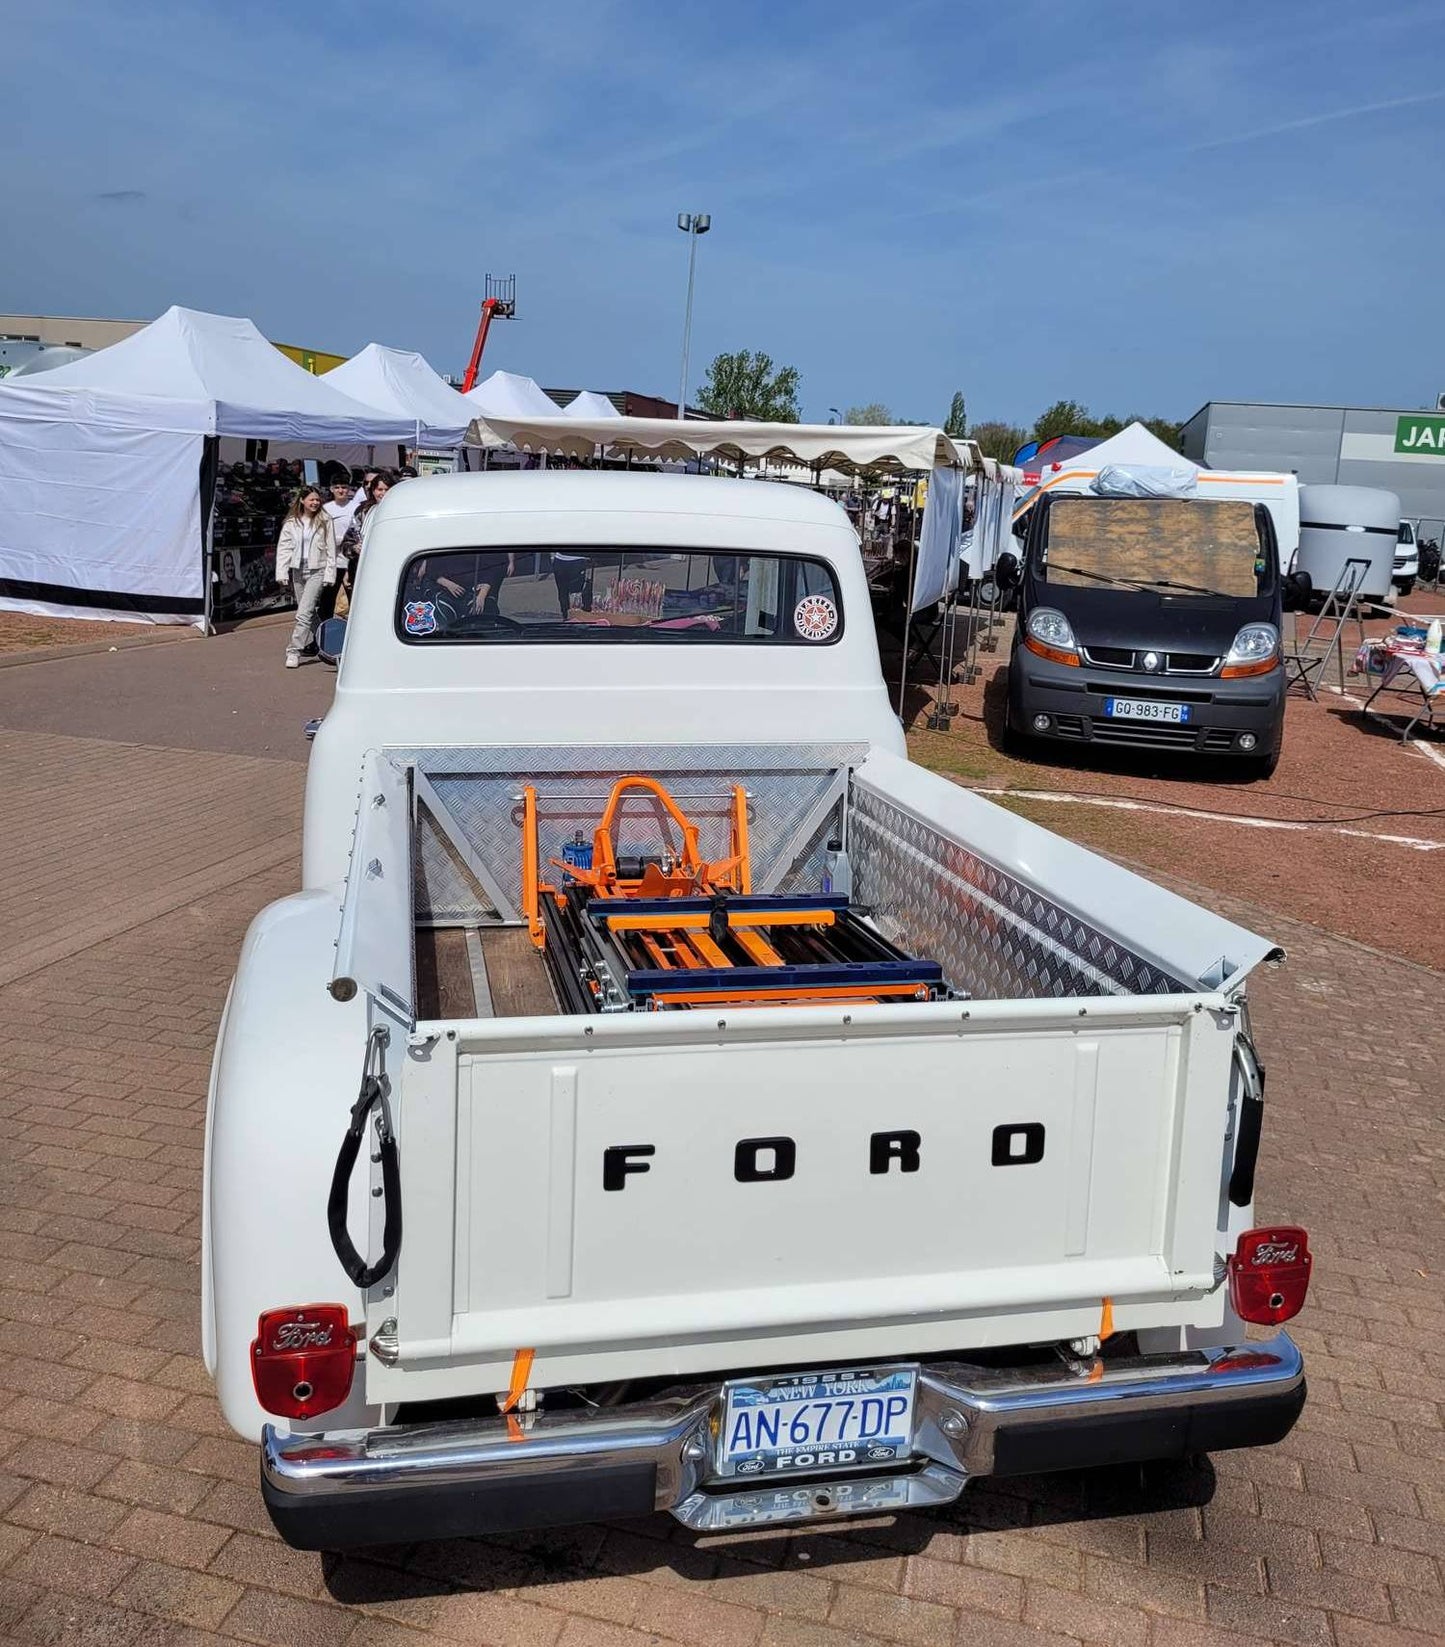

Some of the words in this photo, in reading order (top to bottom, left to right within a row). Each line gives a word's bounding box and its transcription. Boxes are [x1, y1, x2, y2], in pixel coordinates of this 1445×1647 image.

[1115, 702, 1180, 720] GQ-983-FG
[603, 1121, 1046, 1192] FORD
[1251, 1242, 1299, 1265] Ford
[272, 1322, 334, 1350] Ford
[776, 1384, 817, 1402] NEW
[729, 1396, 908, 1452] AN-677-DP
[776, 1449, 857, 1469] FORD
